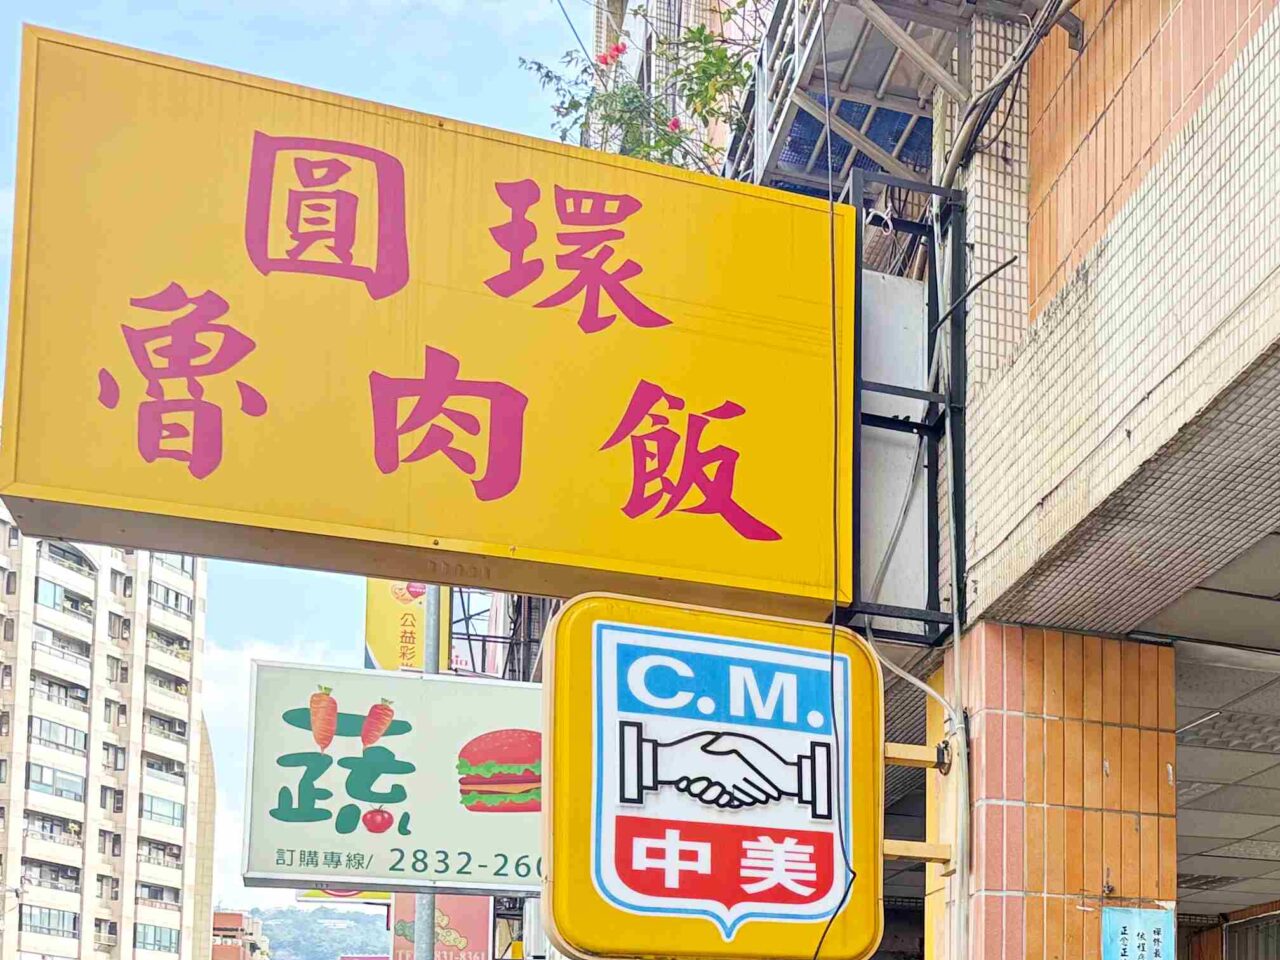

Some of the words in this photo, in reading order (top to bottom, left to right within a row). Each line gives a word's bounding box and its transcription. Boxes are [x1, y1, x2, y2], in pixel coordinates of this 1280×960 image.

[245, 130, 673, 335] 圓環
[98, 281, 783, 542] 魯肉飯
[399, 612, 417, 668] 公益彩
[626, 653, 826, 729] C.M.
[631, 828, 817, 898] 中美
